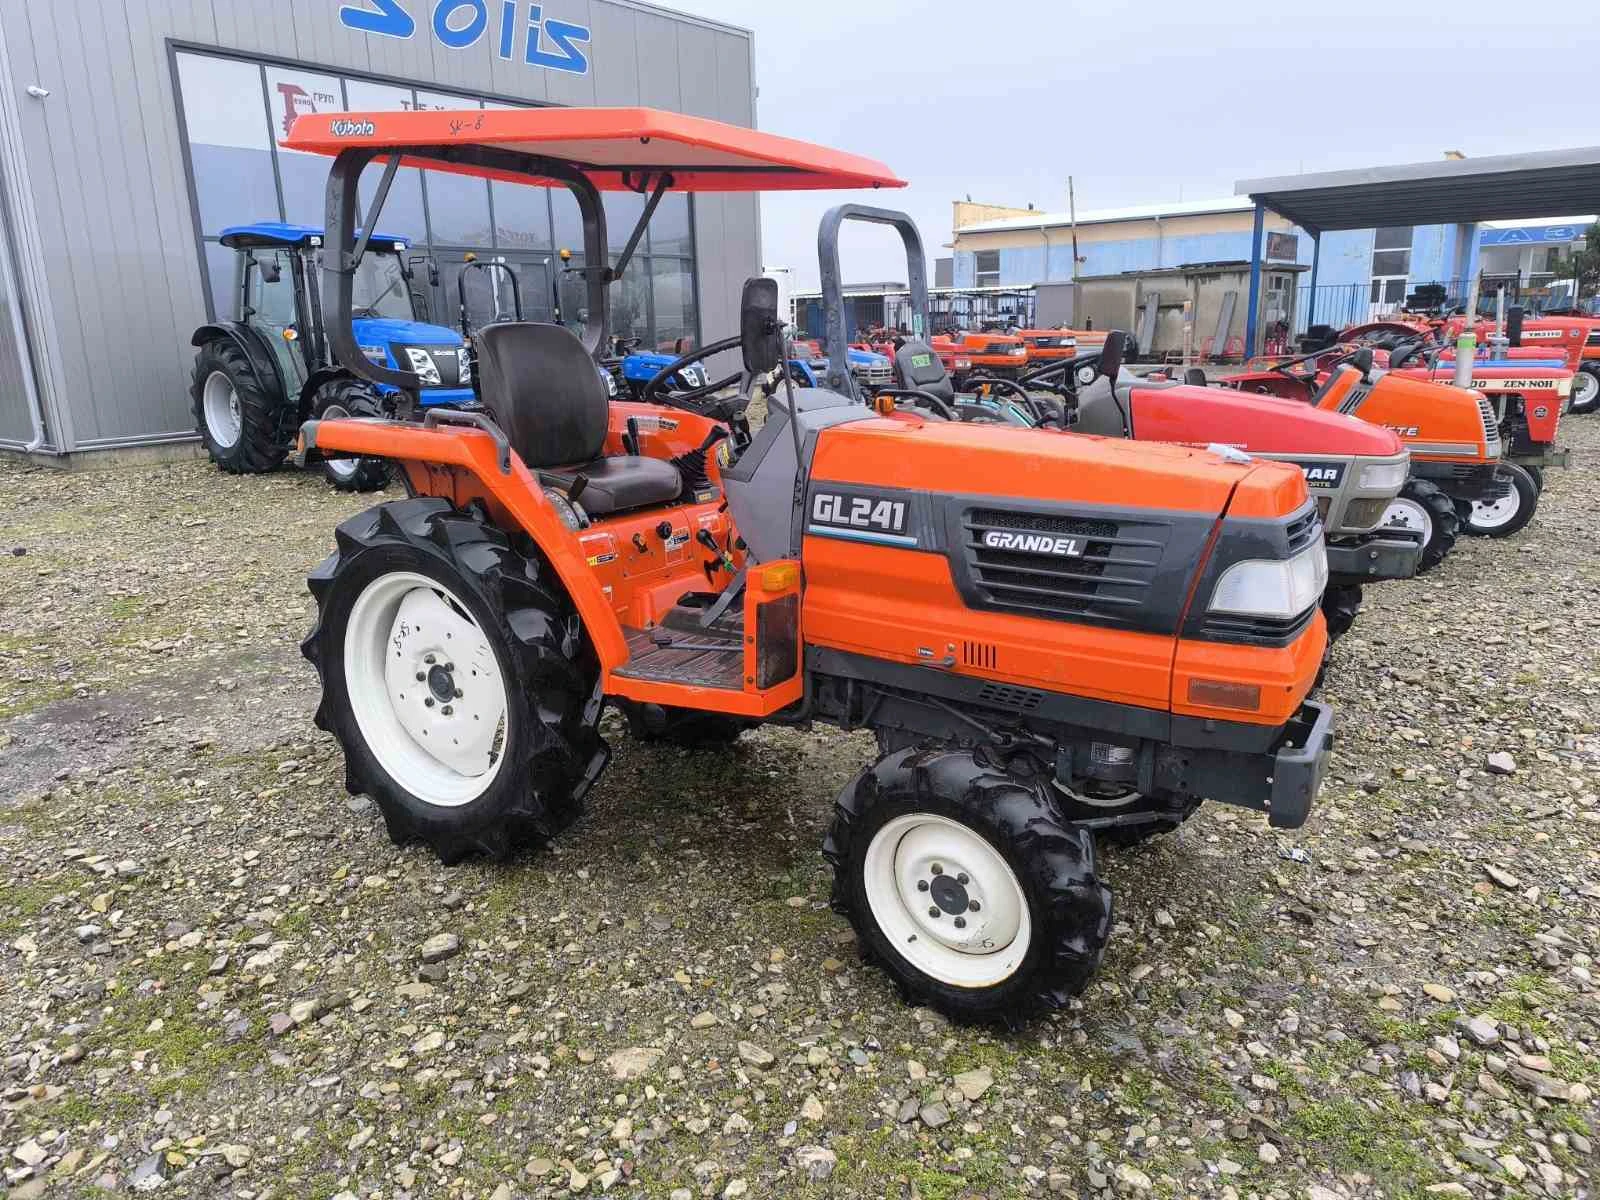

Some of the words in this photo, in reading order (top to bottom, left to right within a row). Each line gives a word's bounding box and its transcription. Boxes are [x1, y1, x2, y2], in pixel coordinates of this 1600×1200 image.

[331, 119, 375, 136] Kubota
[812, 493, 905, 531] GL241
[984, 531, 1081, 556] GRANDEL
